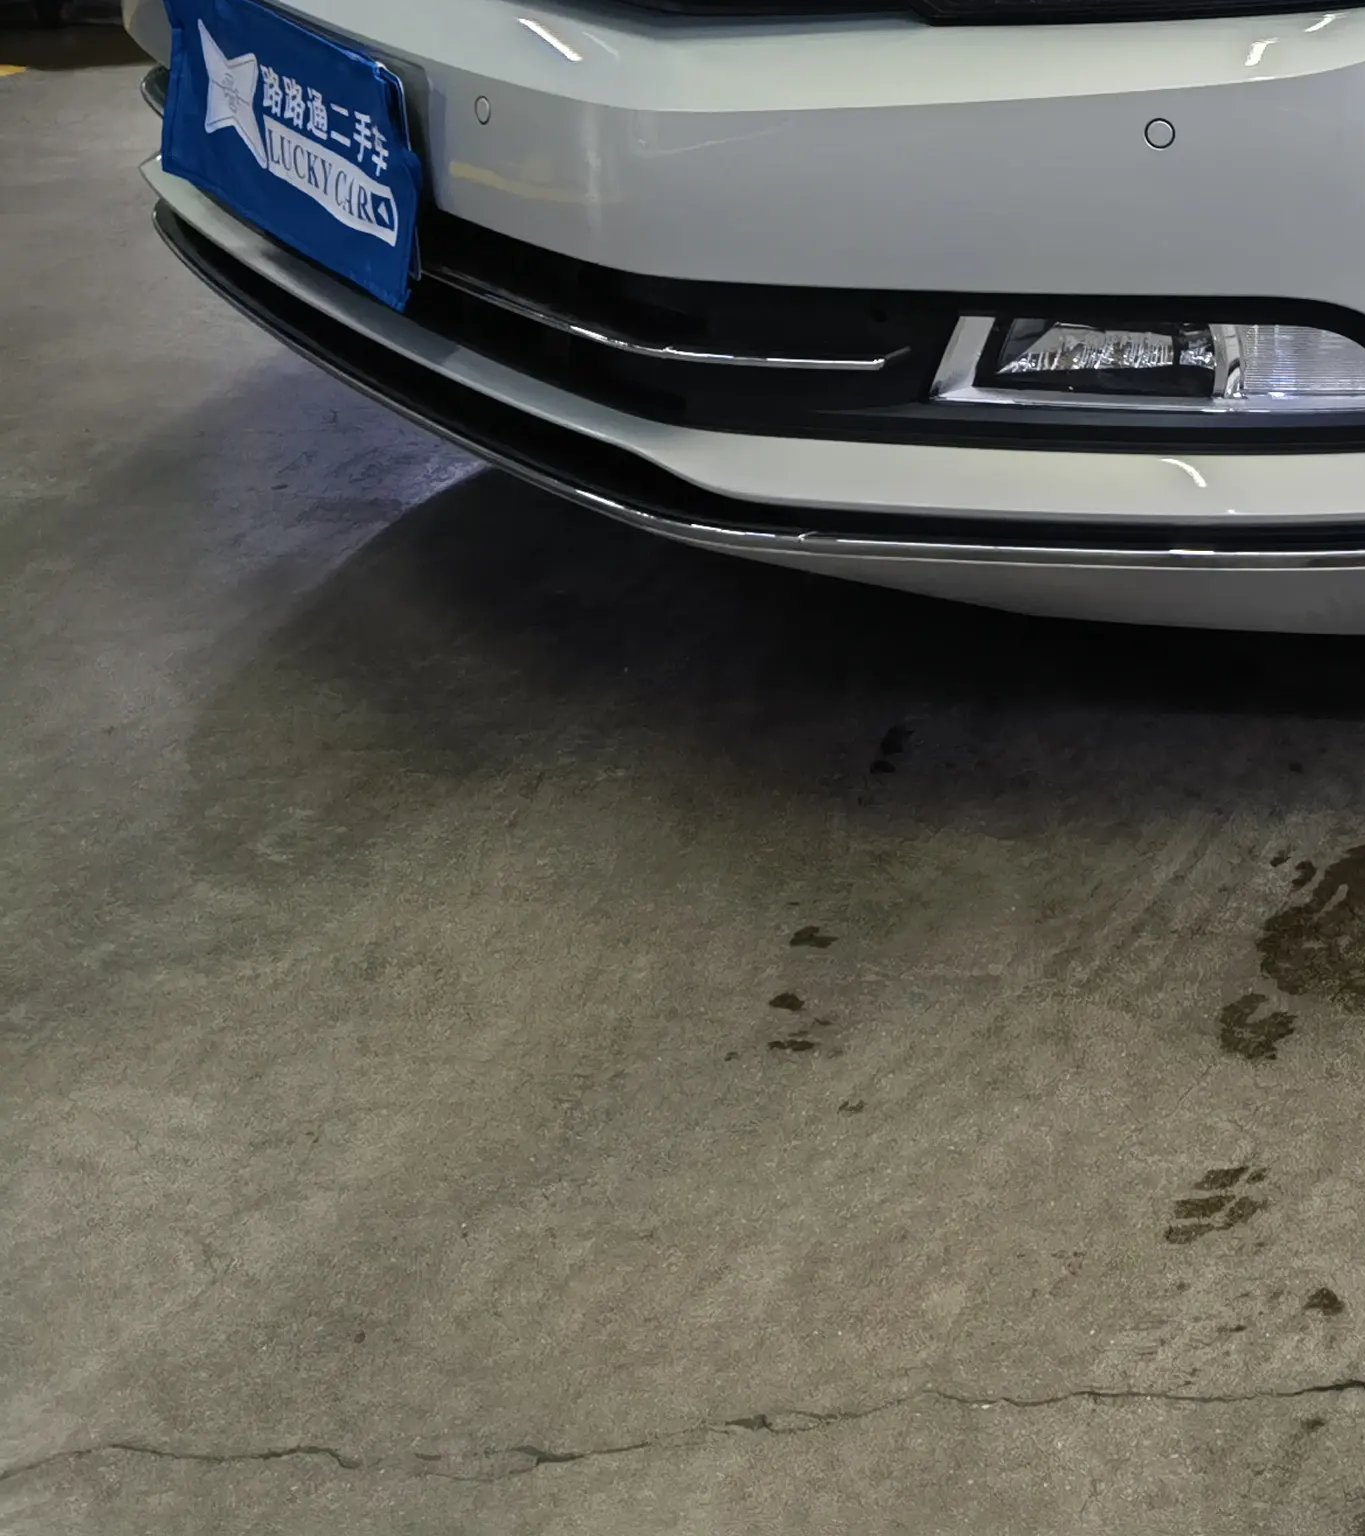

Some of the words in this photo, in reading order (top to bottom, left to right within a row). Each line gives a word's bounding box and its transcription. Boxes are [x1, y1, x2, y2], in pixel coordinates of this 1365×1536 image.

[260, 64, 390, 177] 路路通二手车
[267, 129, 333, 196] LUCKY
[334, 169, 376, 227] CAR
